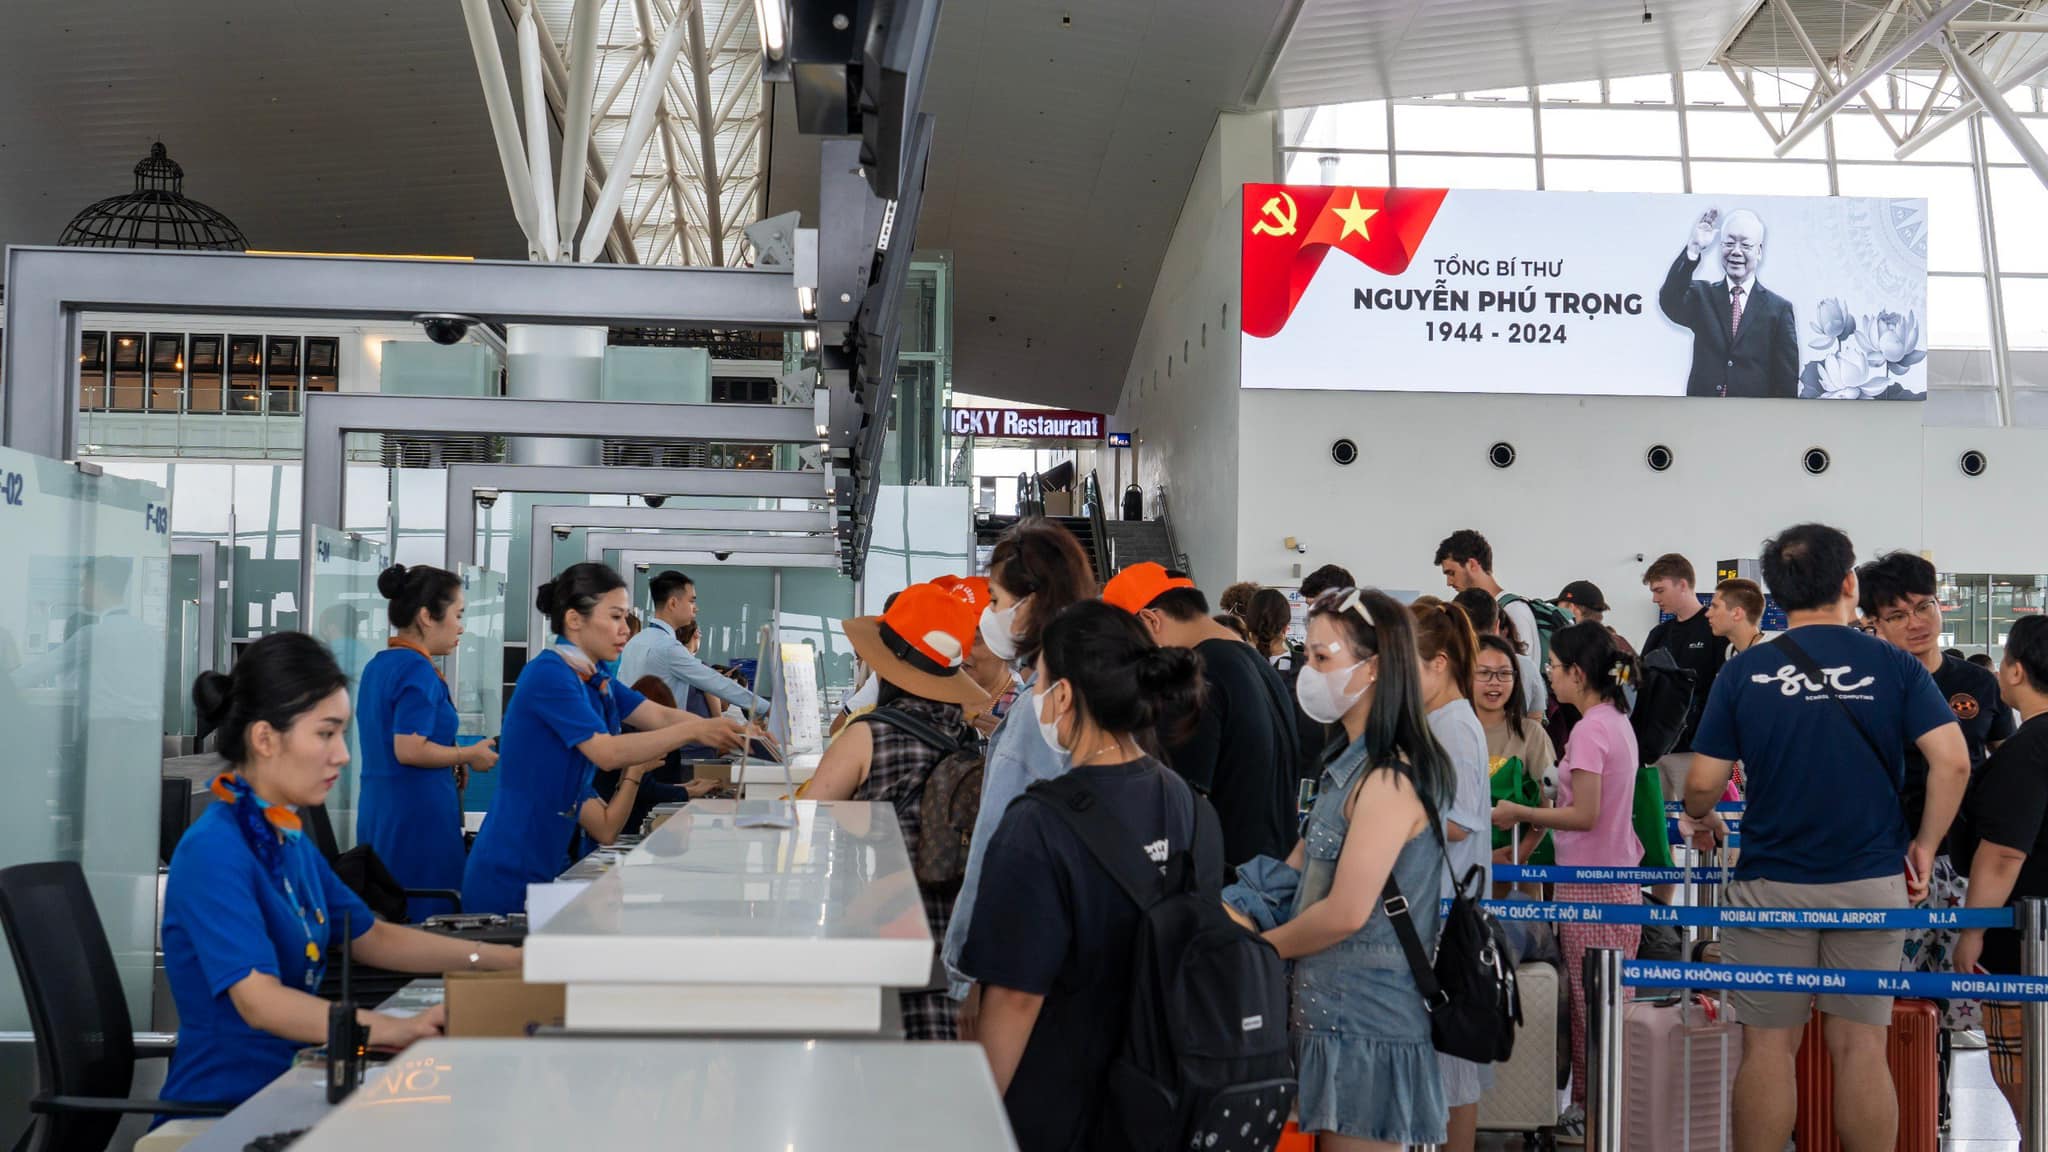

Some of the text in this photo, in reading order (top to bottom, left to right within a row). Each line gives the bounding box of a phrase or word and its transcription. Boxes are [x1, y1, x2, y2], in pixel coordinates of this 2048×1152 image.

[1434, 253, 1564, 277] TỔNG BÍ THƯ
[1353, 279, 1643, 320] NGUYỄN PHÚ TRỌNG
[1426, 321, 1483, 343] 1944
[1508, 323, 1567, 344] 2024
[1004, 411, 1098, 437] Restaurant
[145, 503, 168, 535] F-03
[1521, 868, 1548, 879] N.I.A
[1576, 869, 1615, 880] NOIBAI
[1559, 905, 1579, 921] NỘI
[1583, 906, 1602, 920] BÀI
[1650, 908, 1678, 921] N.I.A
[1720, 910, 1756, 922] NOIBAI
[1758, 911, 1840, 924] INTERNTIONAL
[1842, 912, 1887, 924] AIRPORT
[1929, 912, 1957, 924] N.I.A
[1643, 965, 1682, 980] HÀNG
[1684, 968, 1733, 983] KHÔNG
[1823, 973, 1846, 988] BÀI
[1877, 977, 1911, 990] N.I.A
[1951, 980, 2000, 993] NOIBAI
